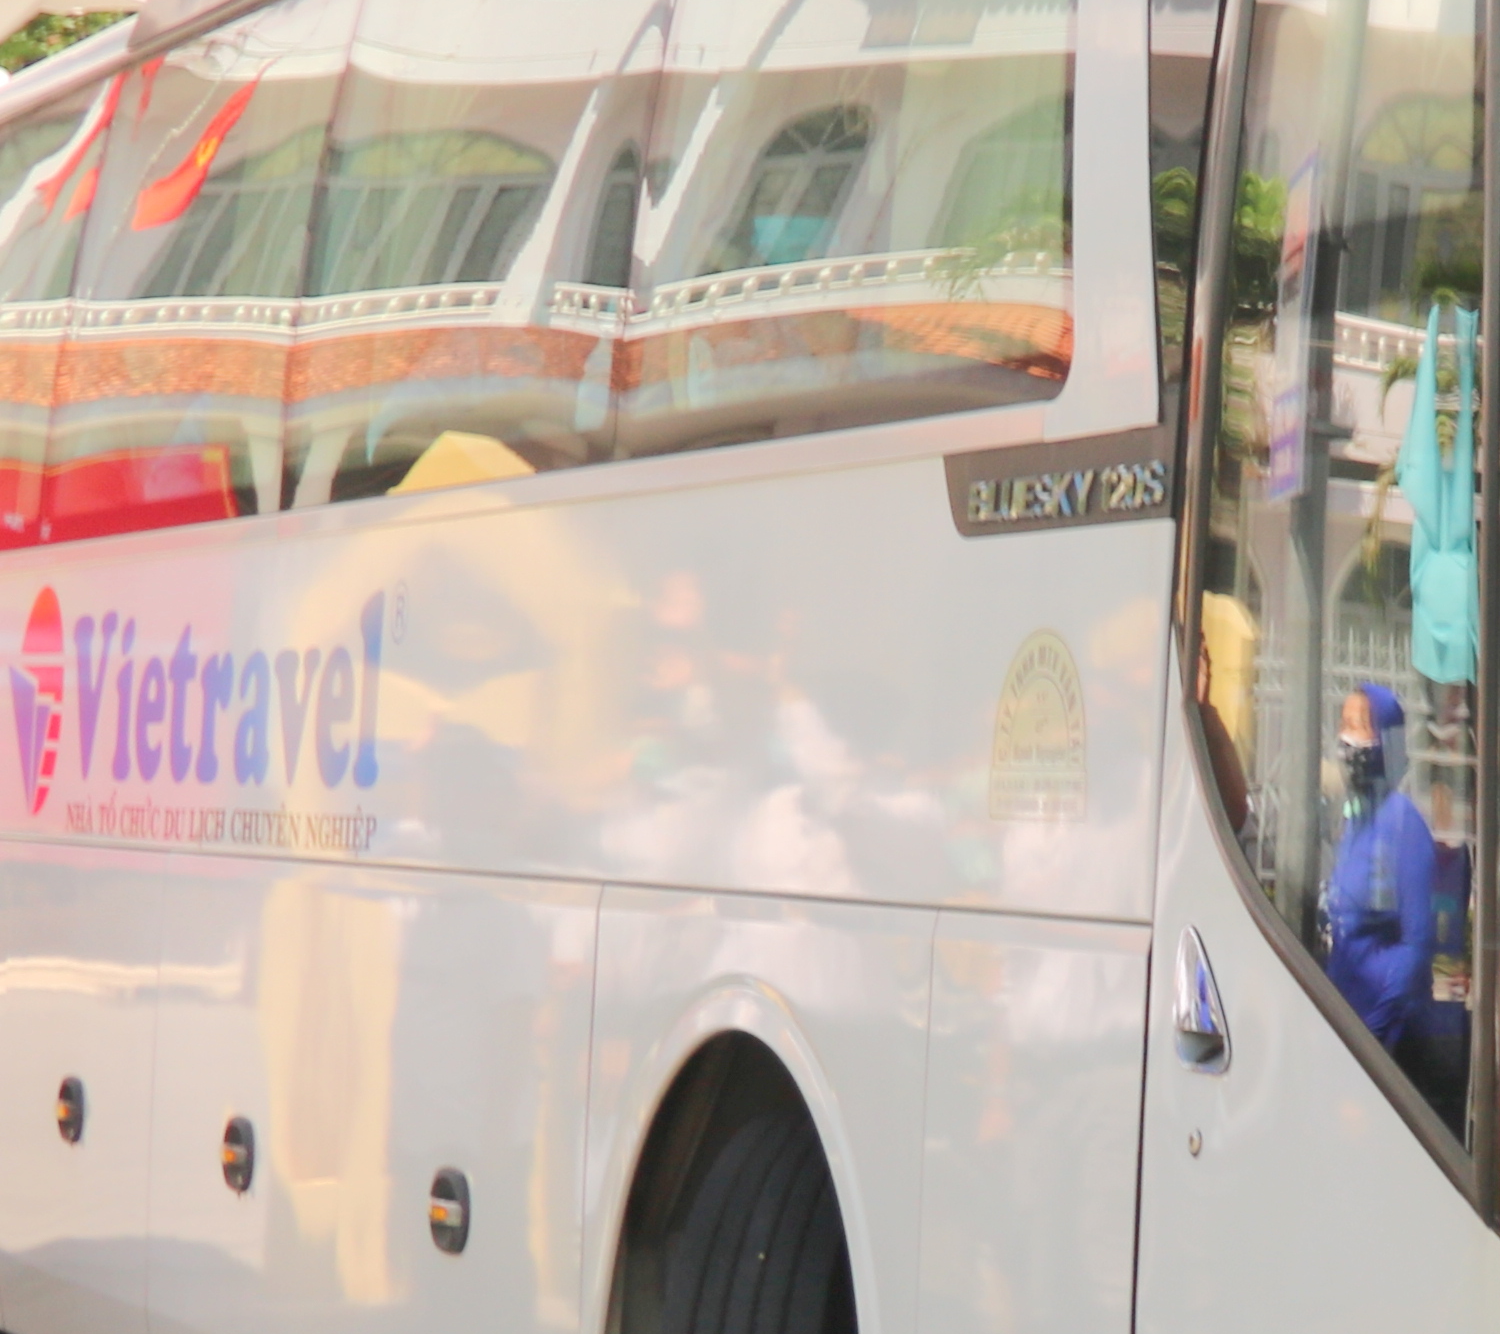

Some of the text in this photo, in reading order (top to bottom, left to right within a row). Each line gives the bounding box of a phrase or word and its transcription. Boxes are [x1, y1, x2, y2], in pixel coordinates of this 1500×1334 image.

[967, 469, 1096, 523] BLUESKY
[73, 590, 385, 789] Vietravel
[66, 795, 93, 834] NHÀ
[164, 806, 185, 841] DU
[189, 806, 225, 849] LỊCH
